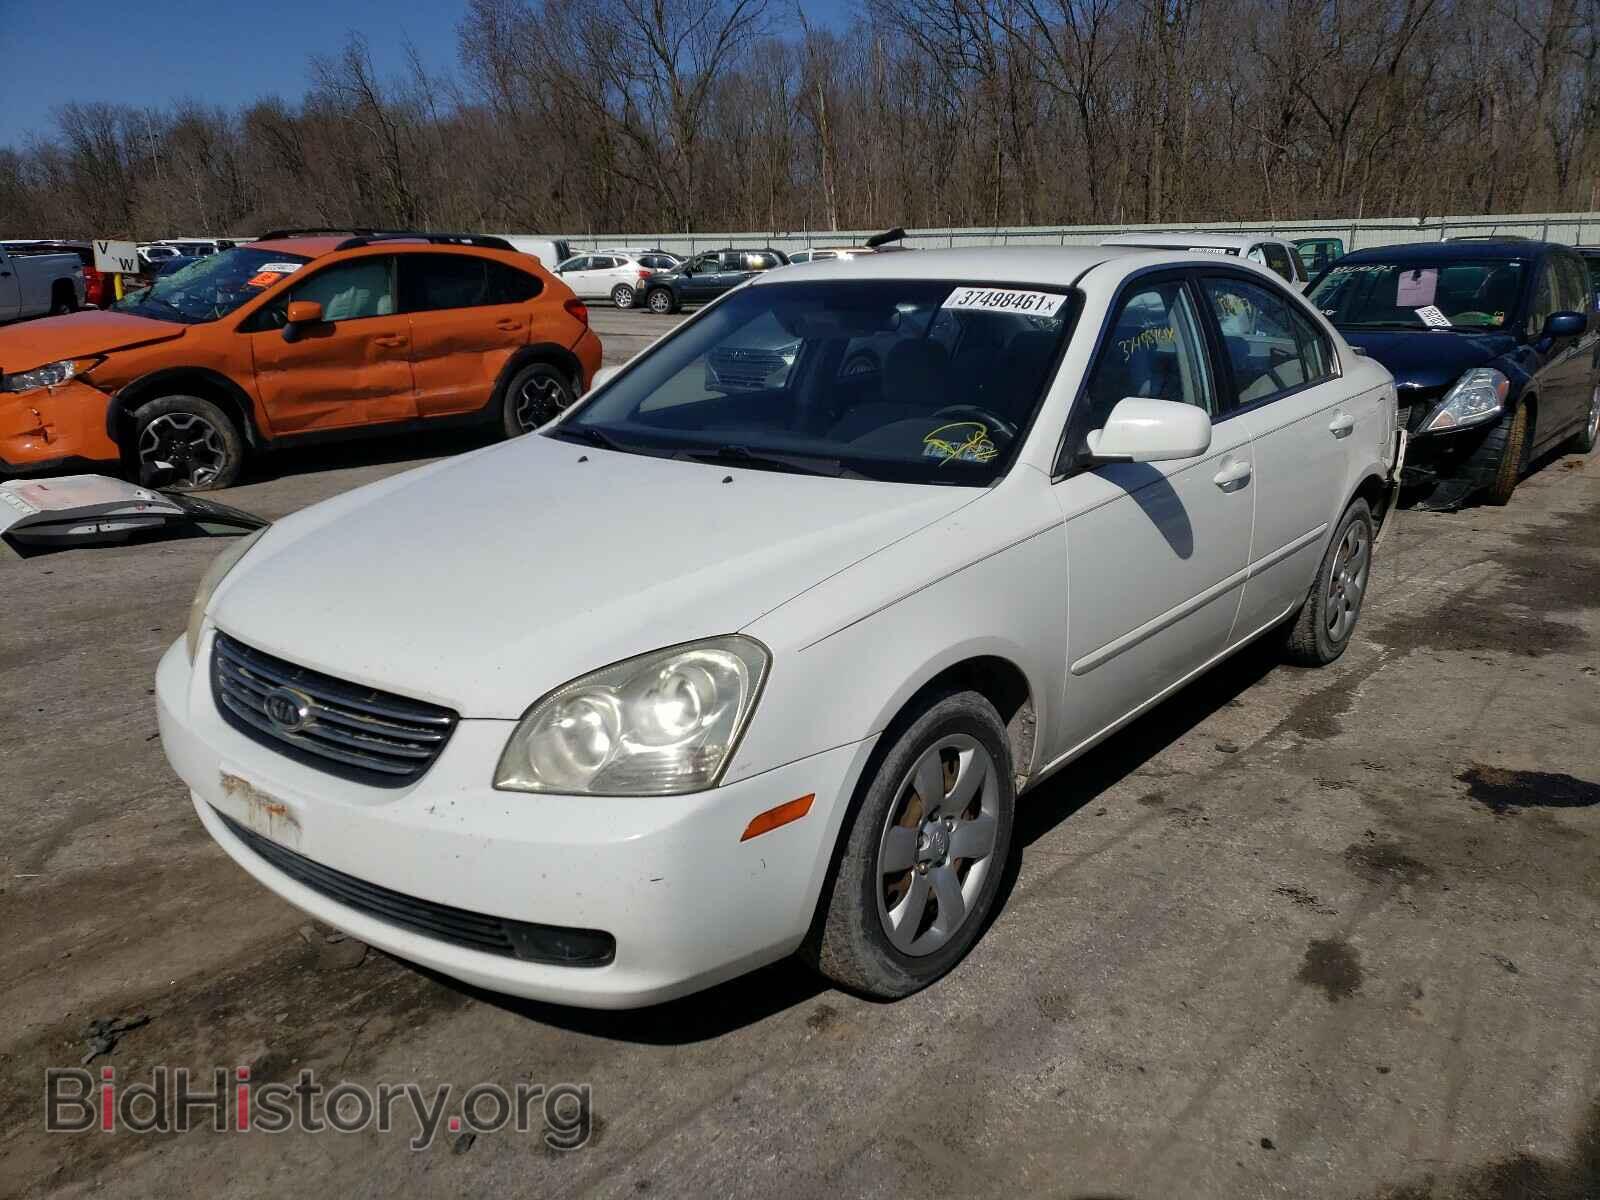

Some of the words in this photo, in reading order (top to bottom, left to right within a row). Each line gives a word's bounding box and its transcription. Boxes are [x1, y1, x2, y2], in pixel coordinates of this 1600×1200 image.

[98, 242, 108, 255] V
[119, 257, 134, 271] W
[958, 290, 1046, 311] 37498461
